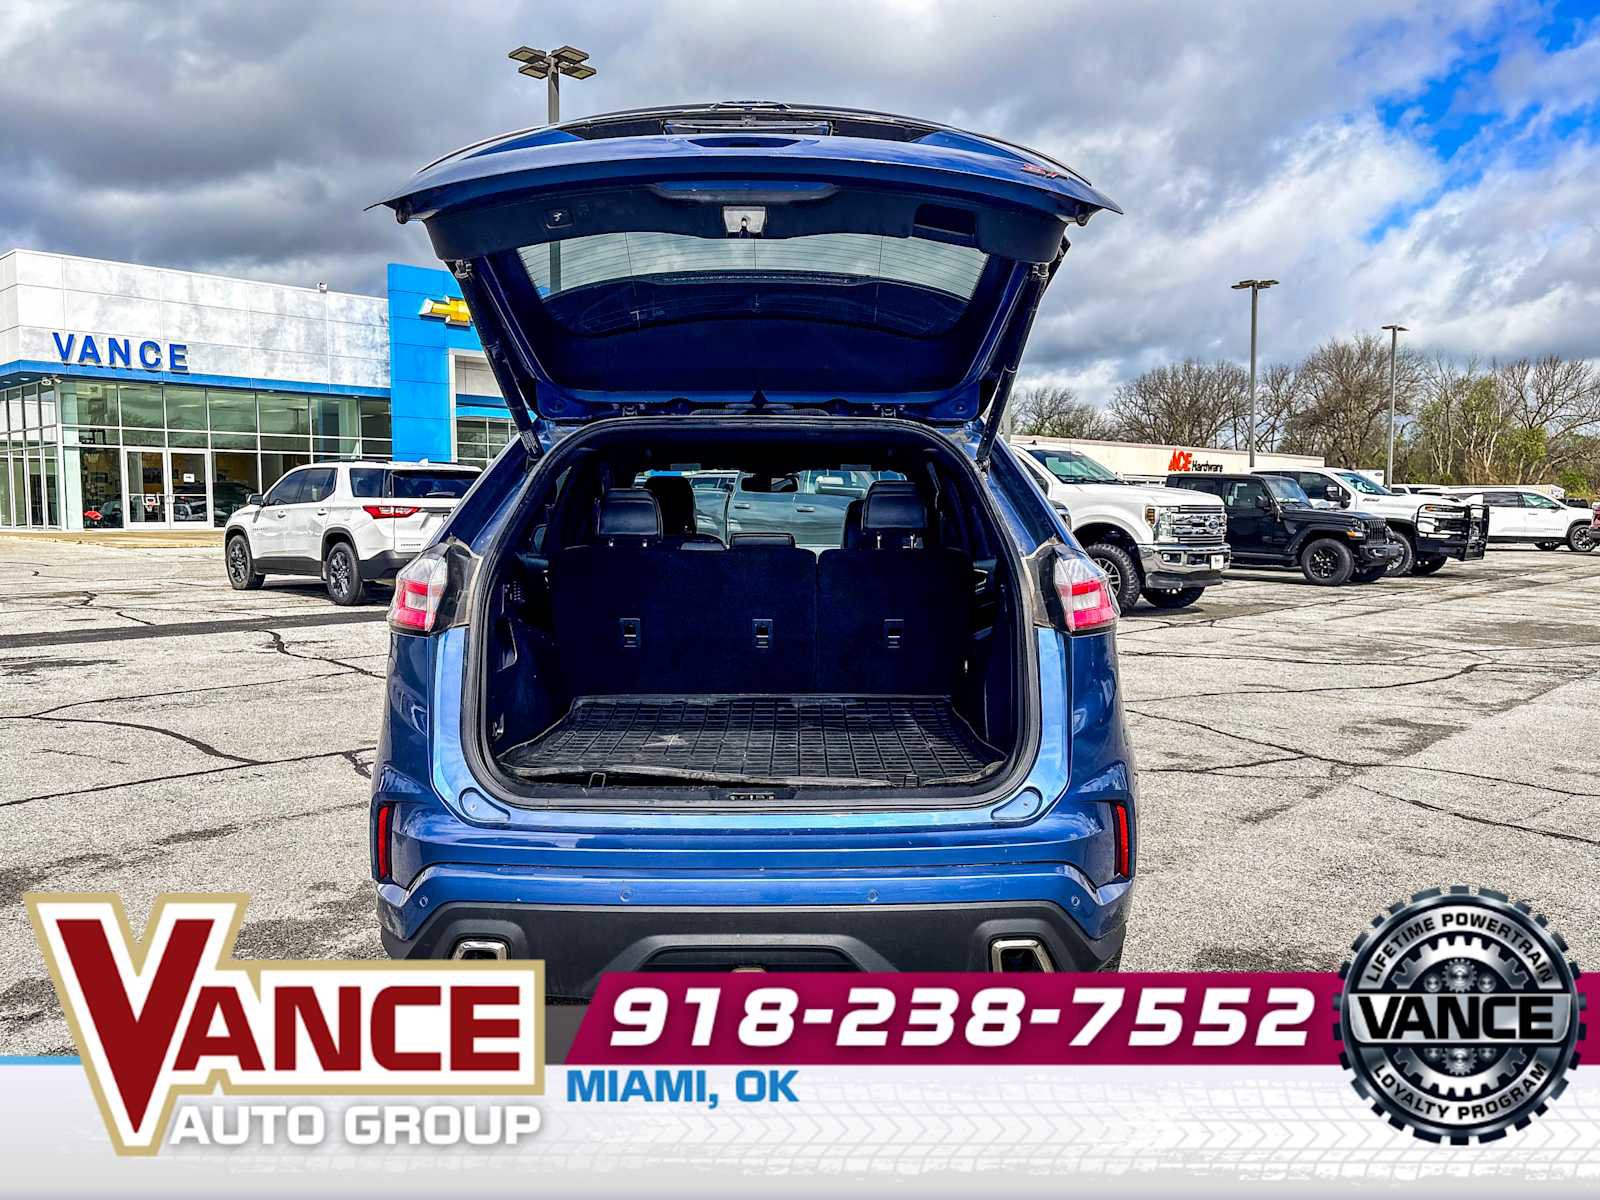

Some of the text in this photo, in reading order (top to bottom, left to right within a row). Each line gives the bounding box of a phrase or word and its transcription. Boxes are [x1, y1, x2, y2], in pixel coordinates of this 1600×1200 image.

[52, 332, 188, 371] VANCE
[1168, 448, 1224, 473] ACE Hardware
